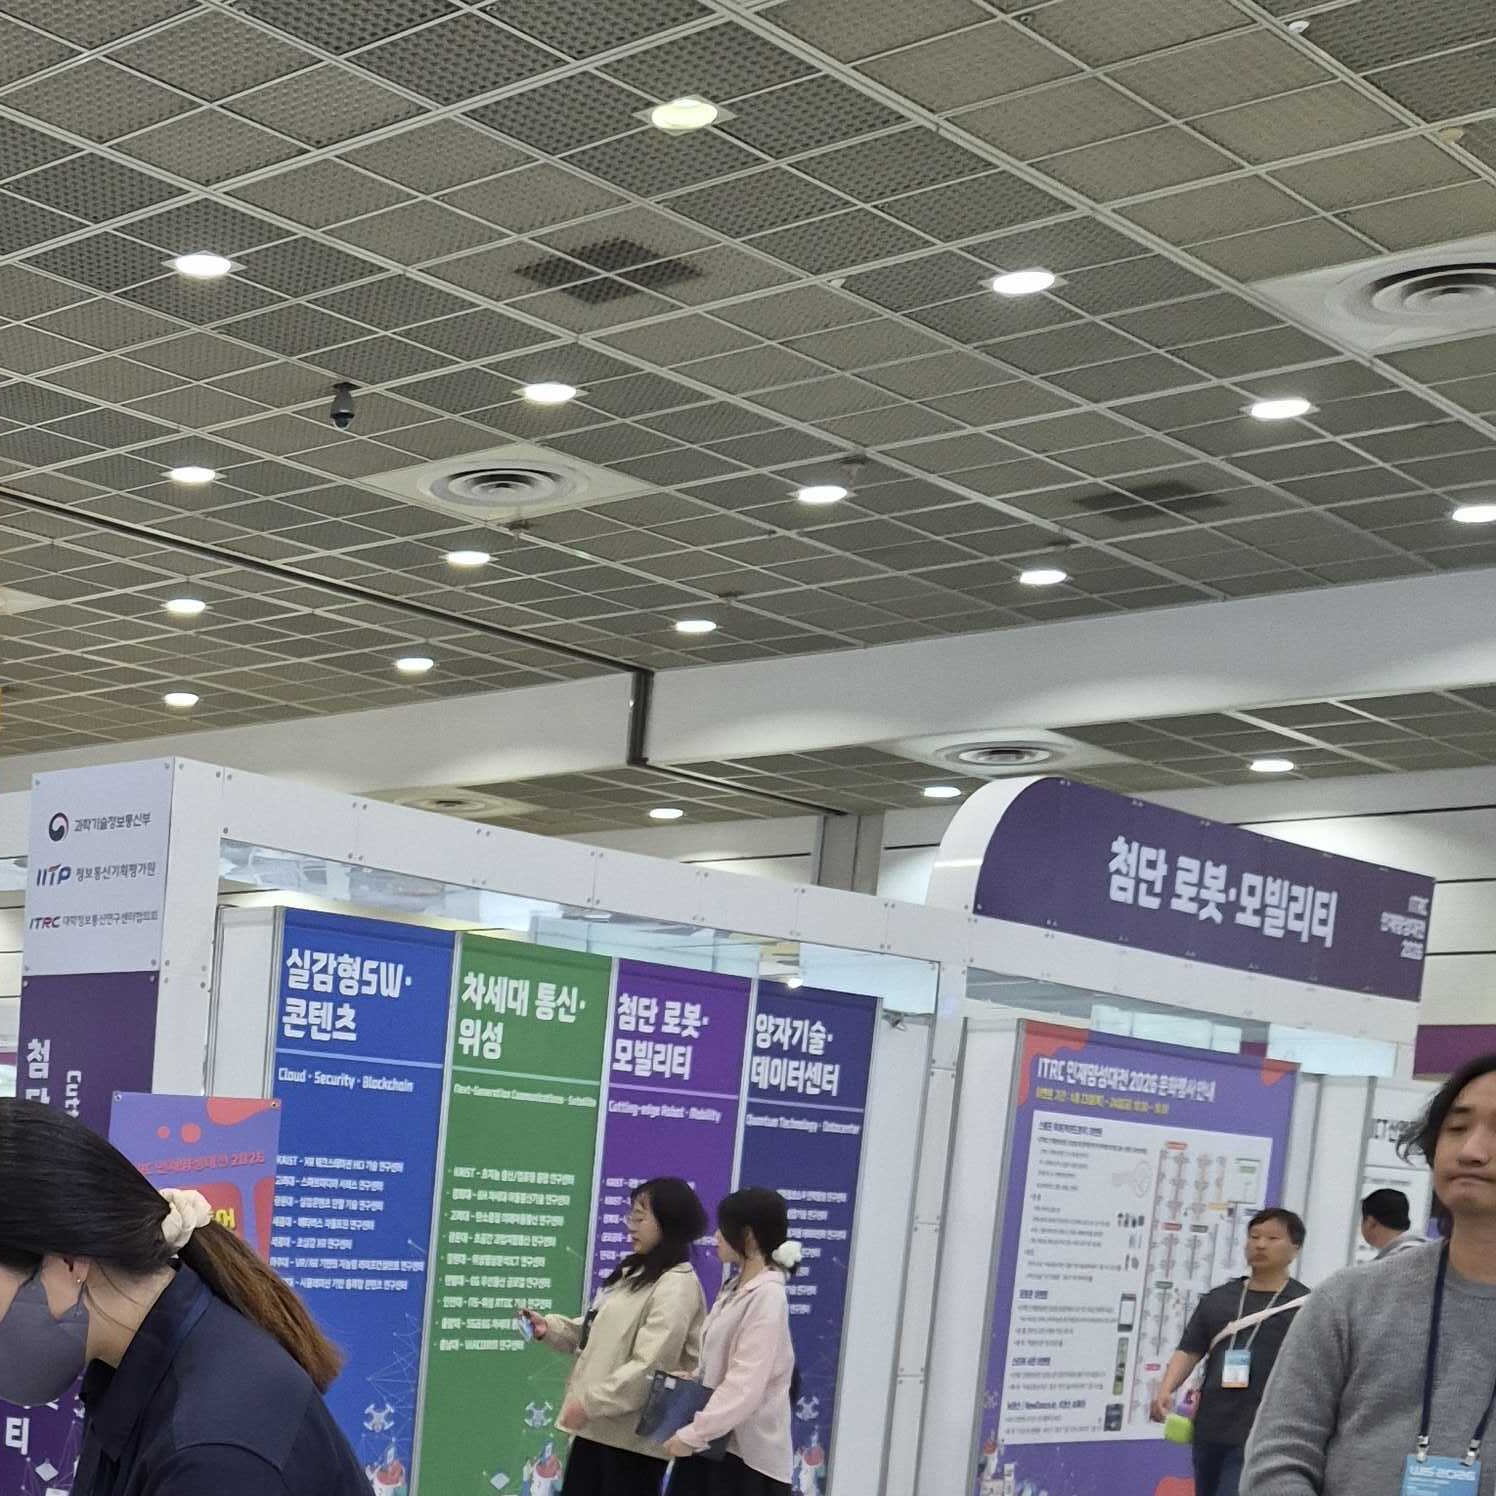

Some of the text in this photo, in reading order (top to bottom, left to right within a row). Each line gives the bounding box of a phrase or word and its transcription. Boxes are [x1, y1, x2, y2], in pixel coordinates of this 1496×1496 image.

[74, 812, 152, 832] 과학기술정보통신부
[36, 861, 157, 887] IITP 정보통신기획평가원
[1109, 835, 1338, 948] 첨단 로봇·모빌리티
[29, 915, 62, 930] ITRC
[461, 971, 530, 1017] 차세대
[617, 992, 658, 1034] 첨단
[282, 997, 357, 1042] 콘텐츠
[458, 1017, 504, 1060] 위성
[278, 1067, 414, 1093] Cloud Security Blockchain
[612, 1038, 693, 1081] 모빌리티
[751, 1056, 840, 1096] 데이터센터
[1037, 1057, 1066, 1082] ITRC
